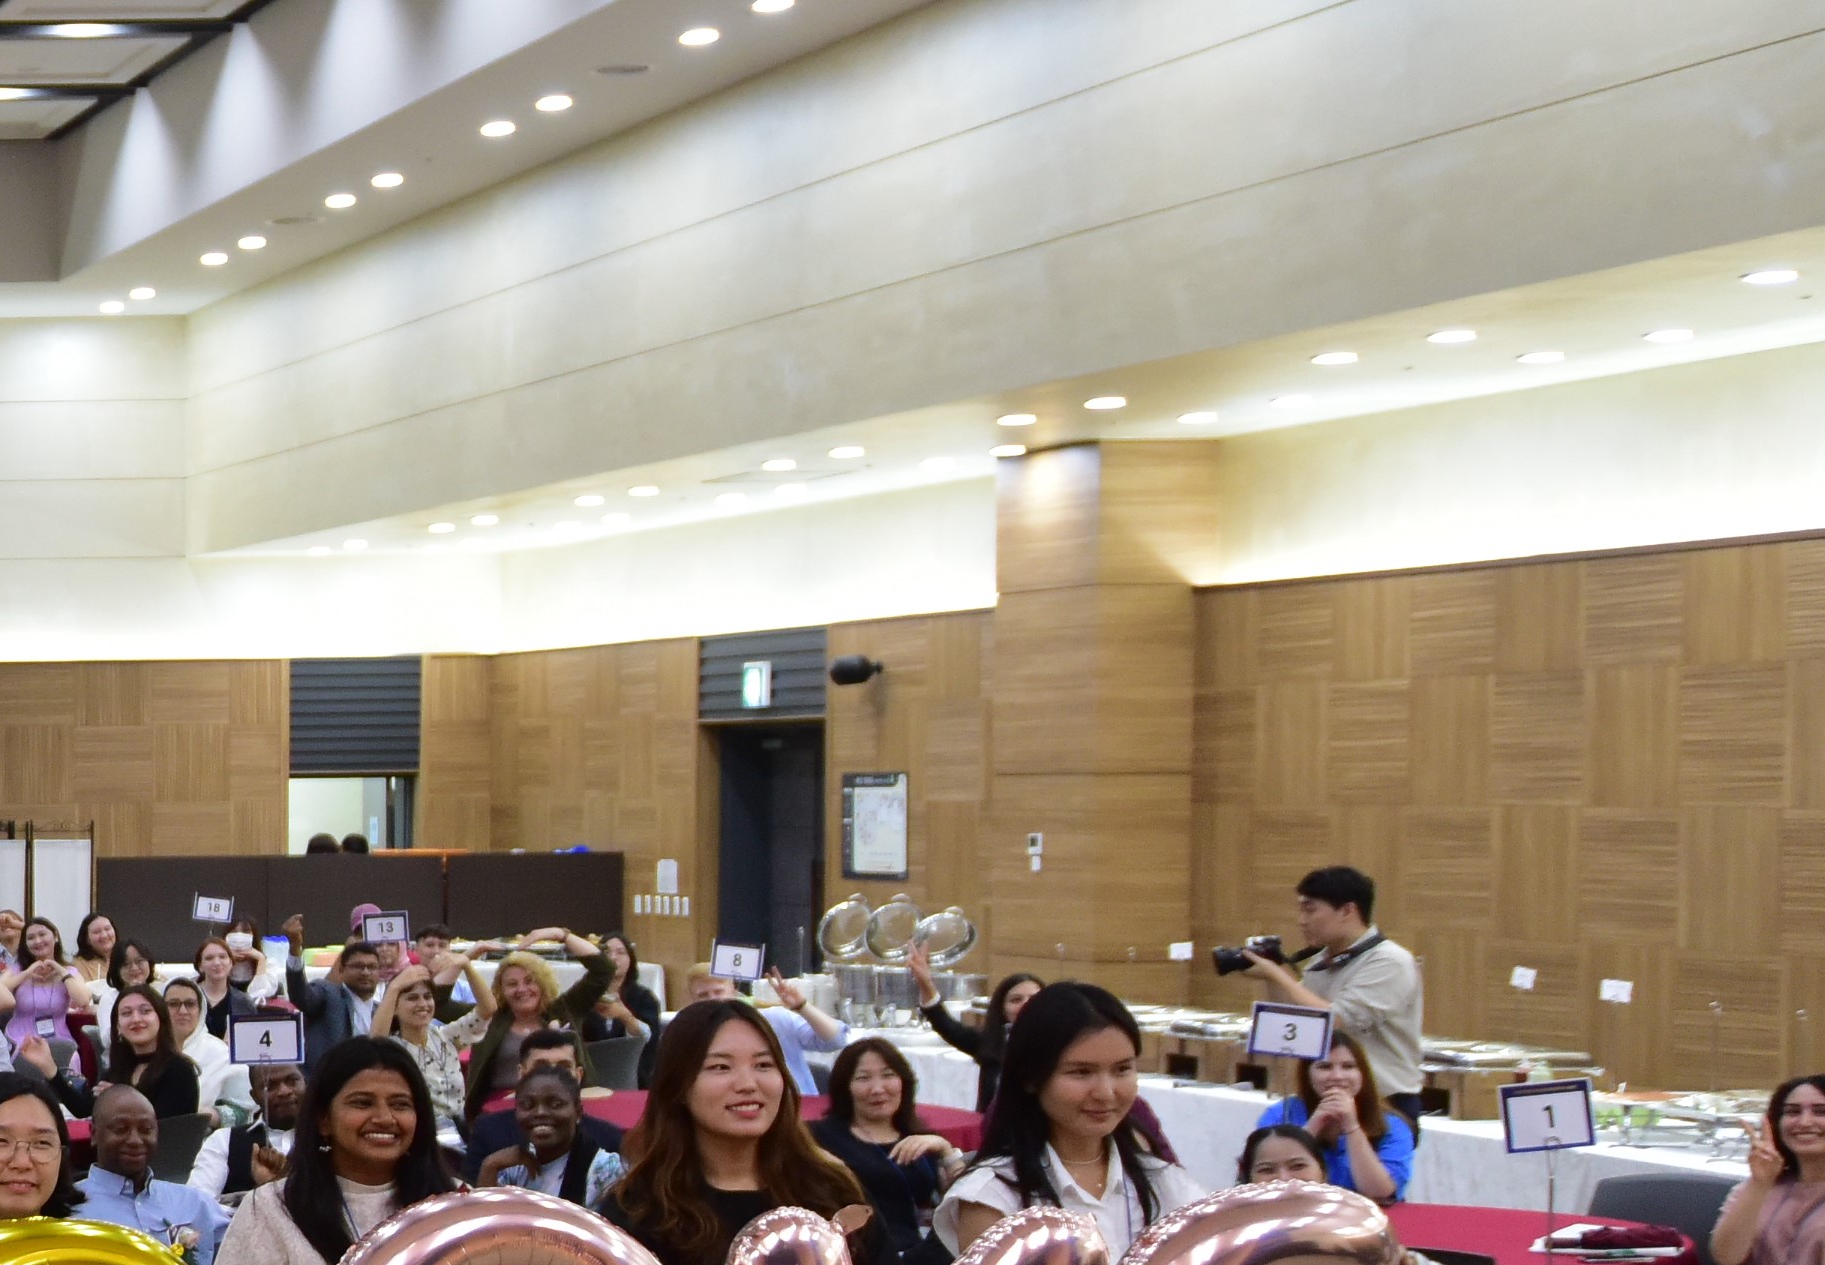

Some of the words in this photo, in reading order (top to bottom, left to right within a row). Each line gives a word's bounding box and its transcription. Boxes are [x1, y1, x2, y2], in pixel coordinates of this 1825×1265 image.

[207, 902, 221, 913] 18
[380, 922, 393, 933] 13
[732, 954, 742, 967] 8
[259, 1030, 272, 1048] 4
[1284, 1022, 1297, 1042] 3
[1543, 1104, 1554, 1128] 1
